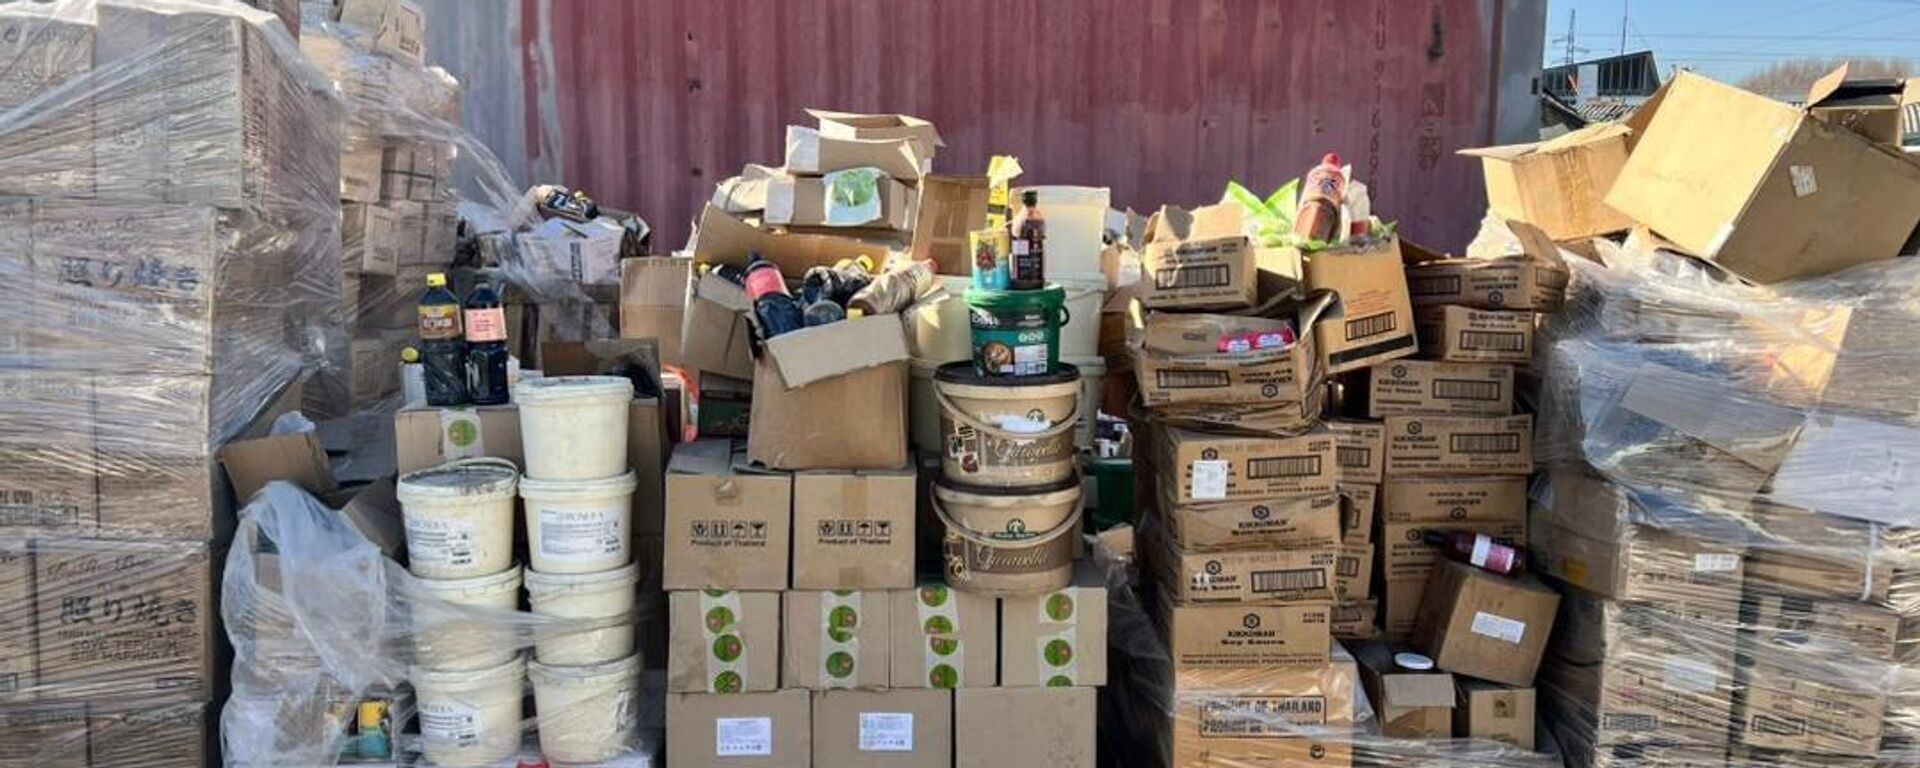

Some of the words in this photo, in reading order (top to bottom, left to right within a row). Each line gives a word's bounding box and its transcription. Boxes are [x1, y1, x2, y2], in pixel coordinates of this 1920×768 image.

[1238, 519, 1287, 530] KIKKOMAN
[691, 539, 722, 547] Product
[733, 539, 766, 547] Thailand
[60, 595, 197, 626] 照り焼き
[1227, 630, 1276, 638] KIKKOMAN
[1220, 638, 1243, 647] Soy
[1247, 638, 1286, 646] Sauce
